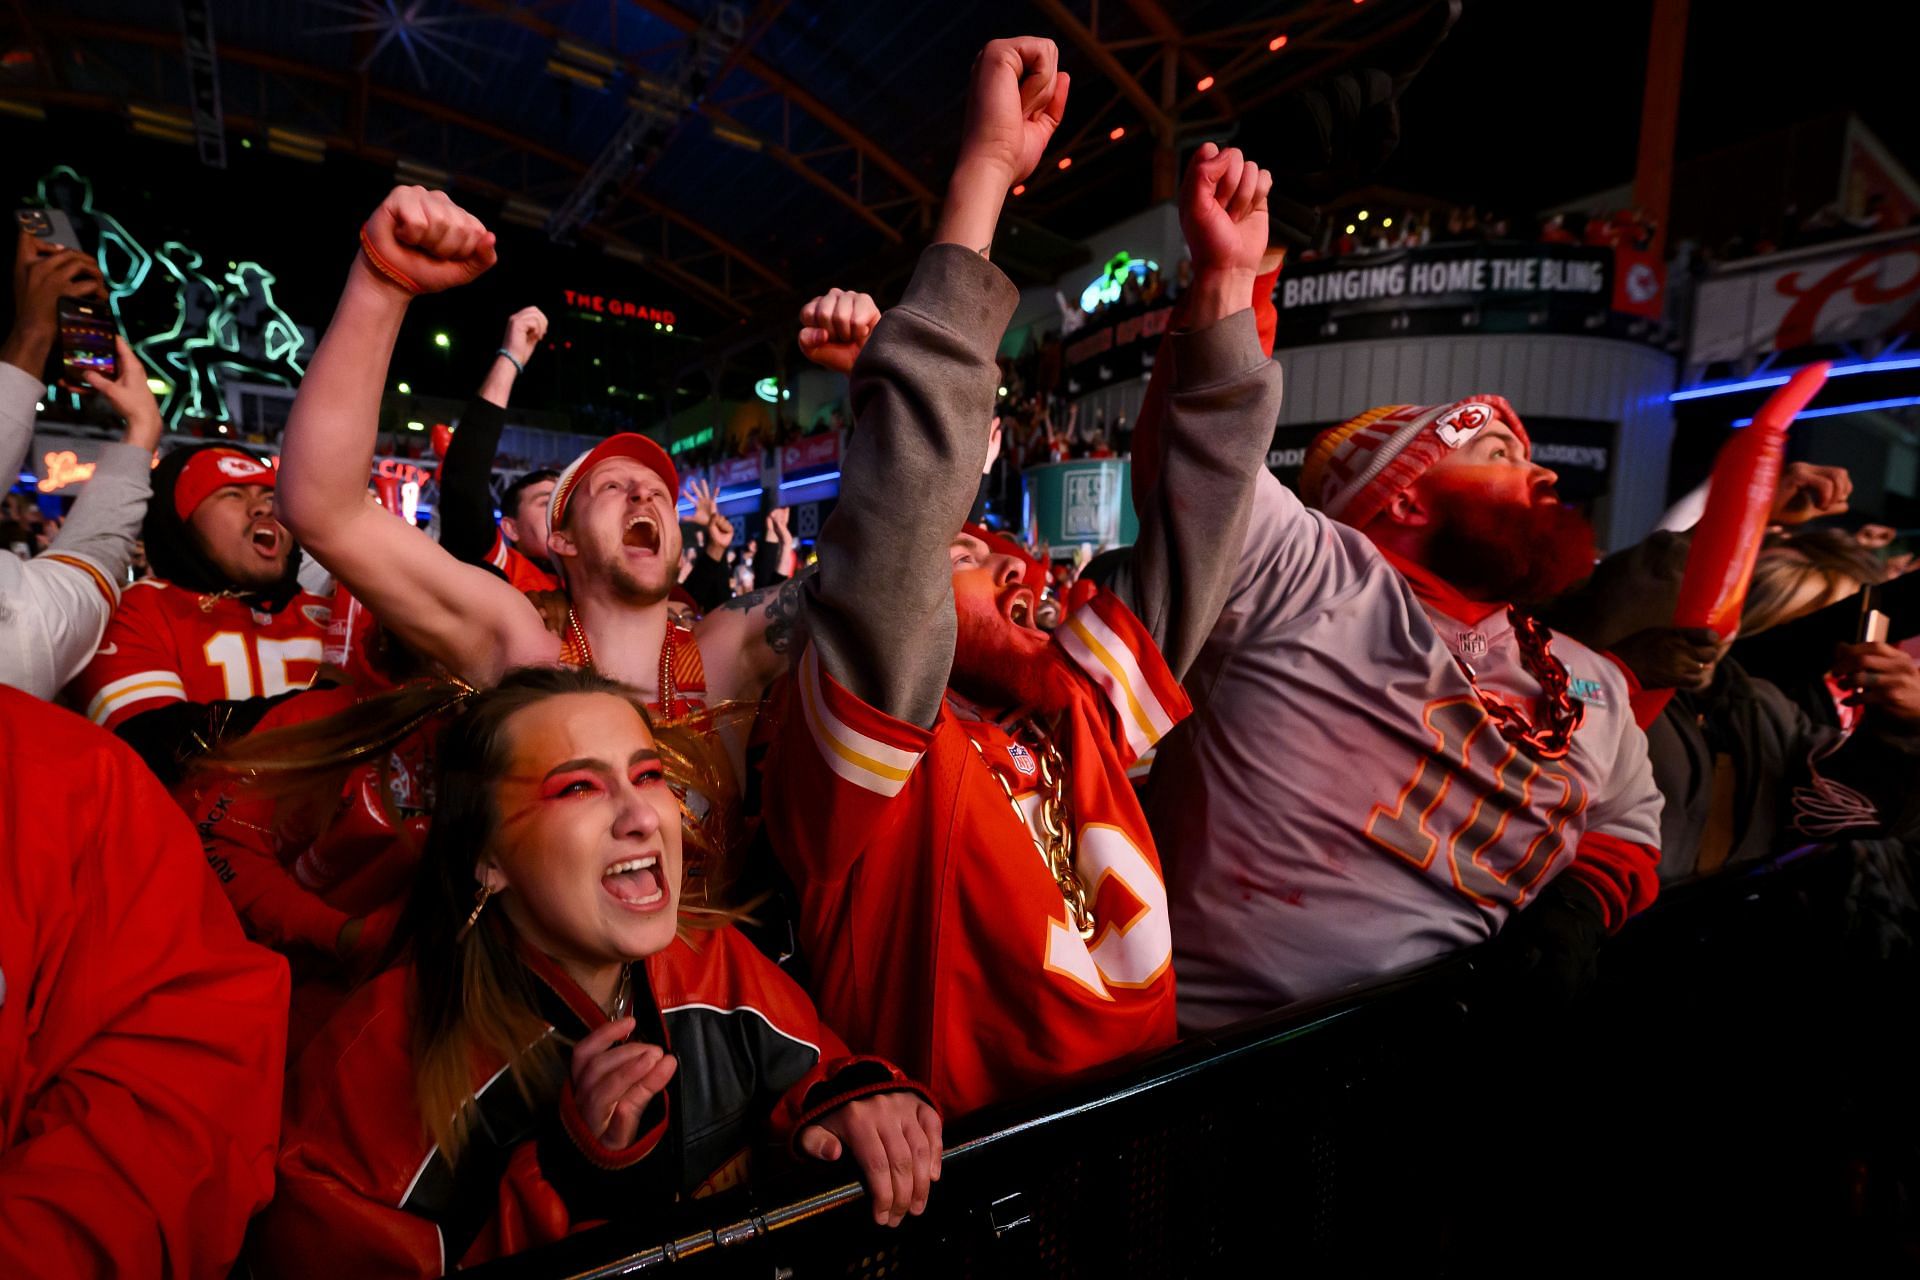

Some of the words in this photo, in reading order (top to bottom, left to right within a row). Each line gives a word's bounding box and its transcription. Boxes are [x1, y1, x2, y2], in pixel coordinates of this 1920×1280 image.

[1283, 263, 1406, 309] BRINGING
[1409, 259, 1487, 293] HOME
[1490, 258, 1538, 290] THE
[1539, 258, 1604, 294] BLING
[563, 288, 605, 313] THE
[607, 298, 677, 325] GRAND
[378, 459, 431, 487] CITY
[1364, 694, 1587, 907] 10
